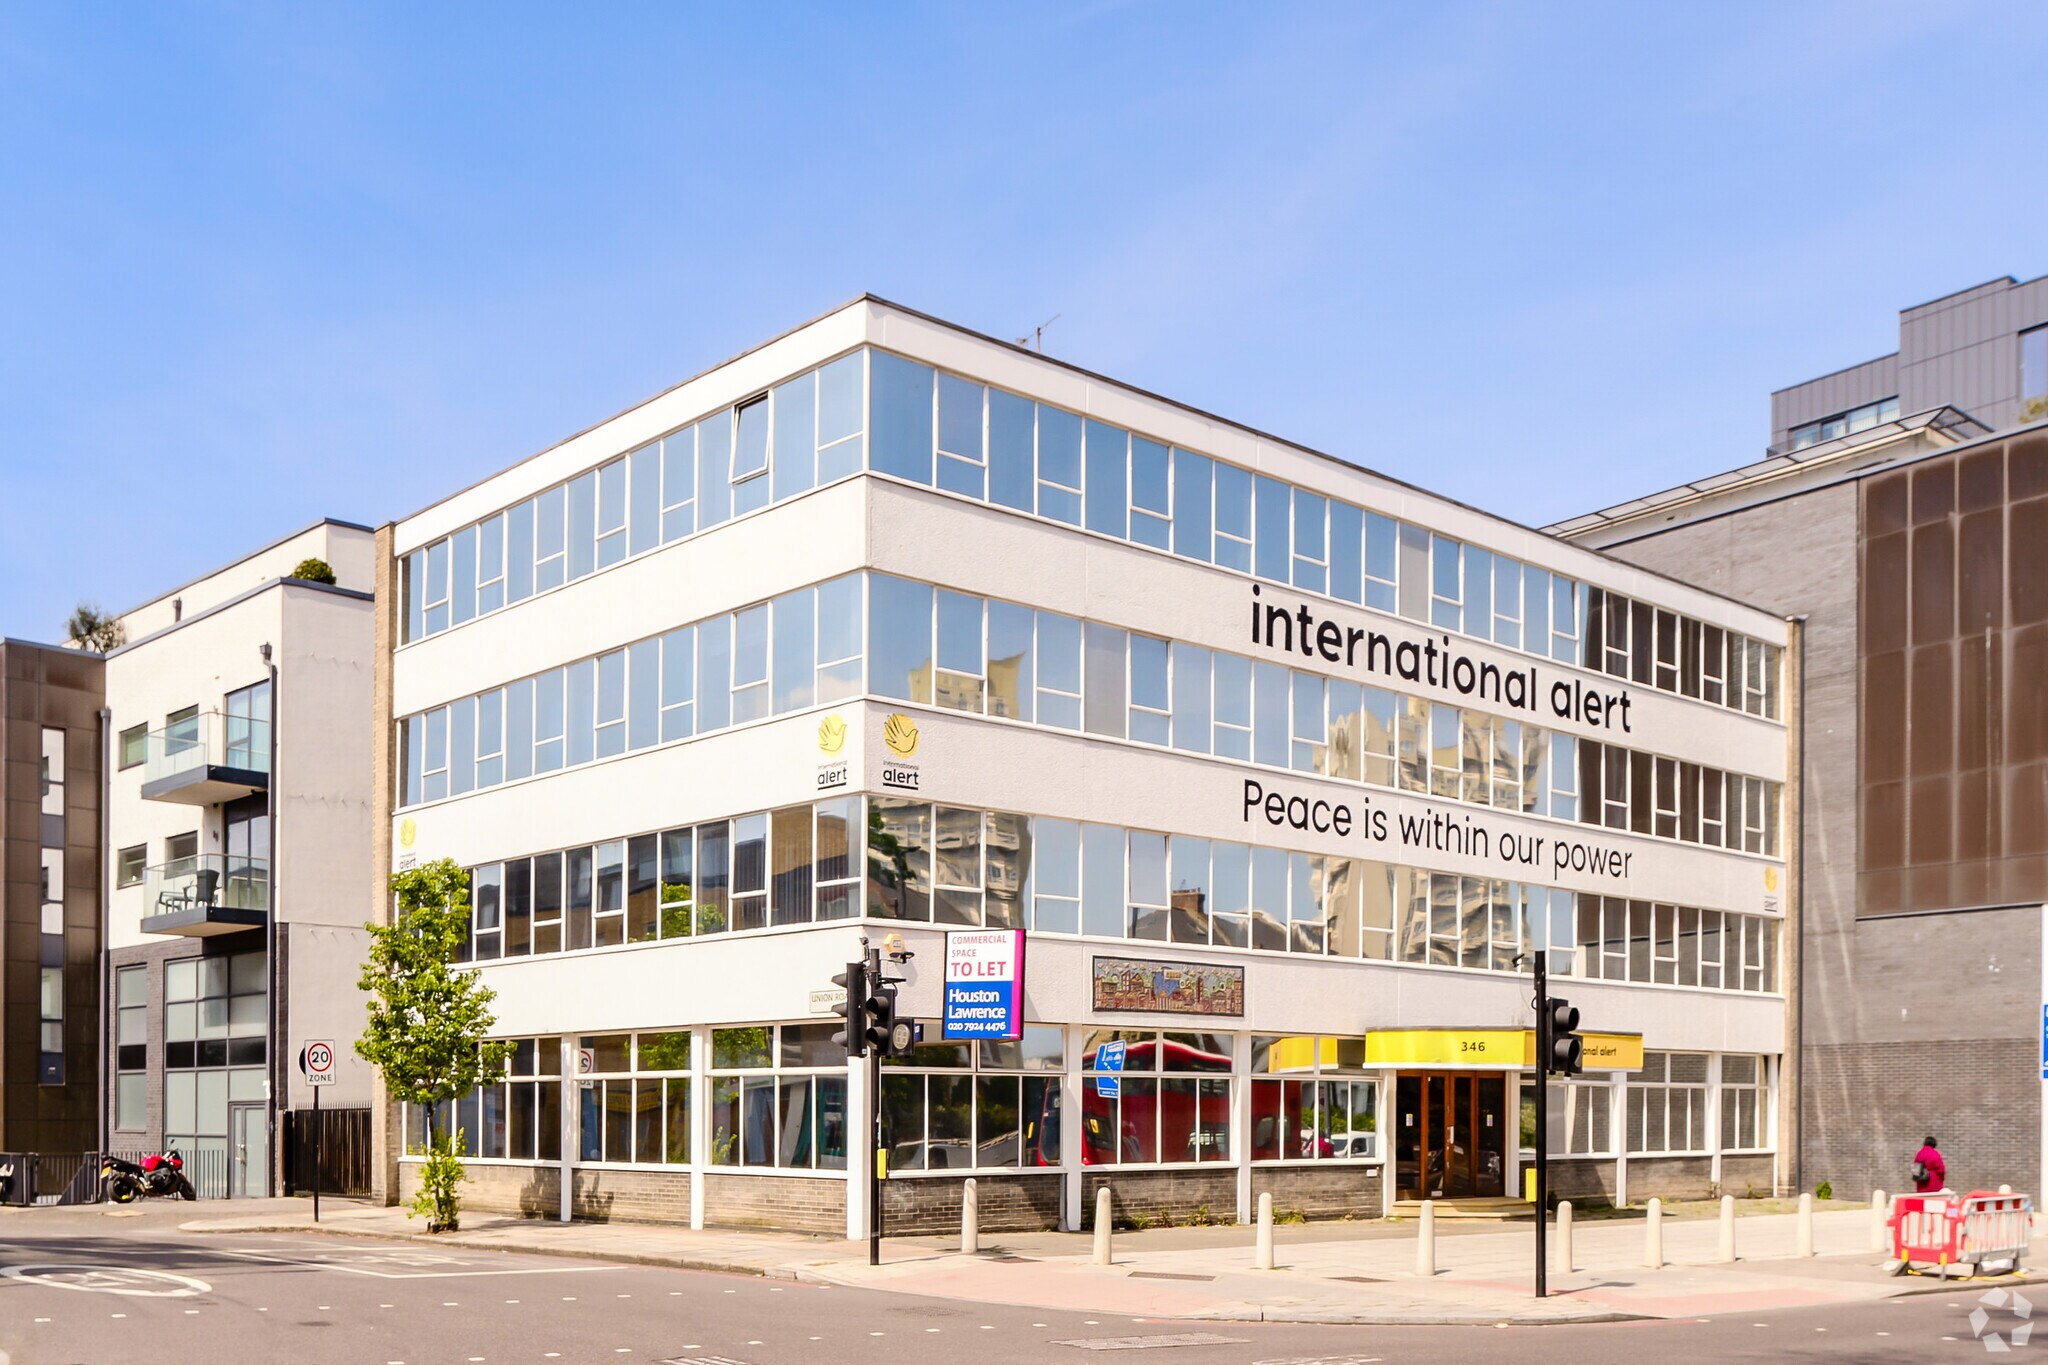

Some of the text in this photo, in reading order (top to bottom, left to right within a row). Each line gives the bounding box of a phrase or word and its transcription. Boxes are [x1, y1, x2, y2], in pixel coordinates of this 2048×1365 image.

[1252, 583, 1631, 733] international alert
[817, 767, 847, 785] alert
[883, 769, 919, 785] alert
[1243, 779, 1632, 881] Peace is within our power
[952, 935, 1007, 945] COMMERCIAL
[951, 949, 977, 957] SPACE
[951, 961, 1007, 977] TO LET
[811, 993, 834, 1003] UNION
[949, 988, 1000, 1003] Houston
[948, 1005, 1007, 1019] Lawrence
[947, 1021, 1007, 1032] 020 7924 4476
[1461, 1041, 1486, 1052] 346
[1600, 1047, 1617, 1057] alert
[311, 1051, 329, 1063] 20
[309, 1074, 332, 1082] ZONE
